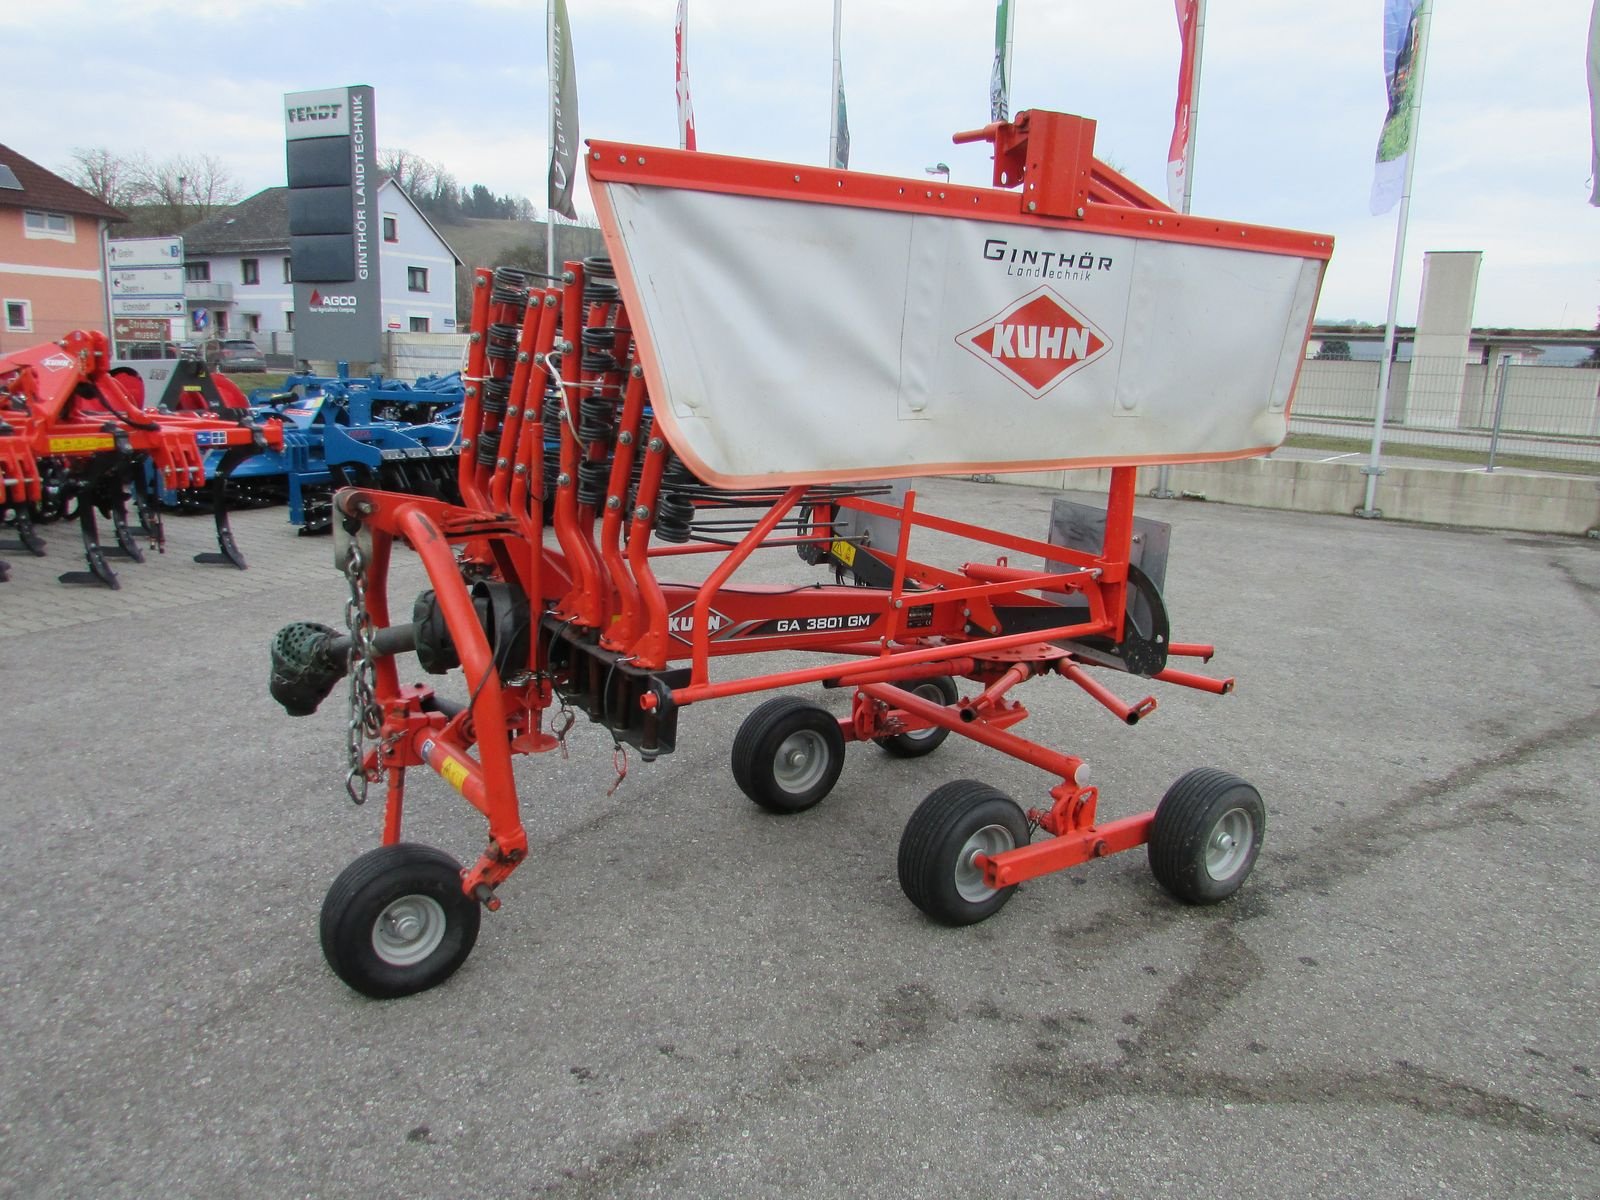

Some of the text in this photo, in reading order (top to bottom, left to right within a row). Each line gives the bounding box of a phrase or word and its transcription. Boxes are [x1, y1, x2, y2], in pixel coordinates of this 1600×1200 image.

[287, 103, 343, 123] FENDT
[352, 94, 369, 280] GINTHÖR LANDTECHNIK
[322, 296, 357, 306] AGCO
[991, 322, 1091, 360] KUHN
[668, 615, 721, 632] KUN
[777, 615, 871, 632] GA 3801 GM
